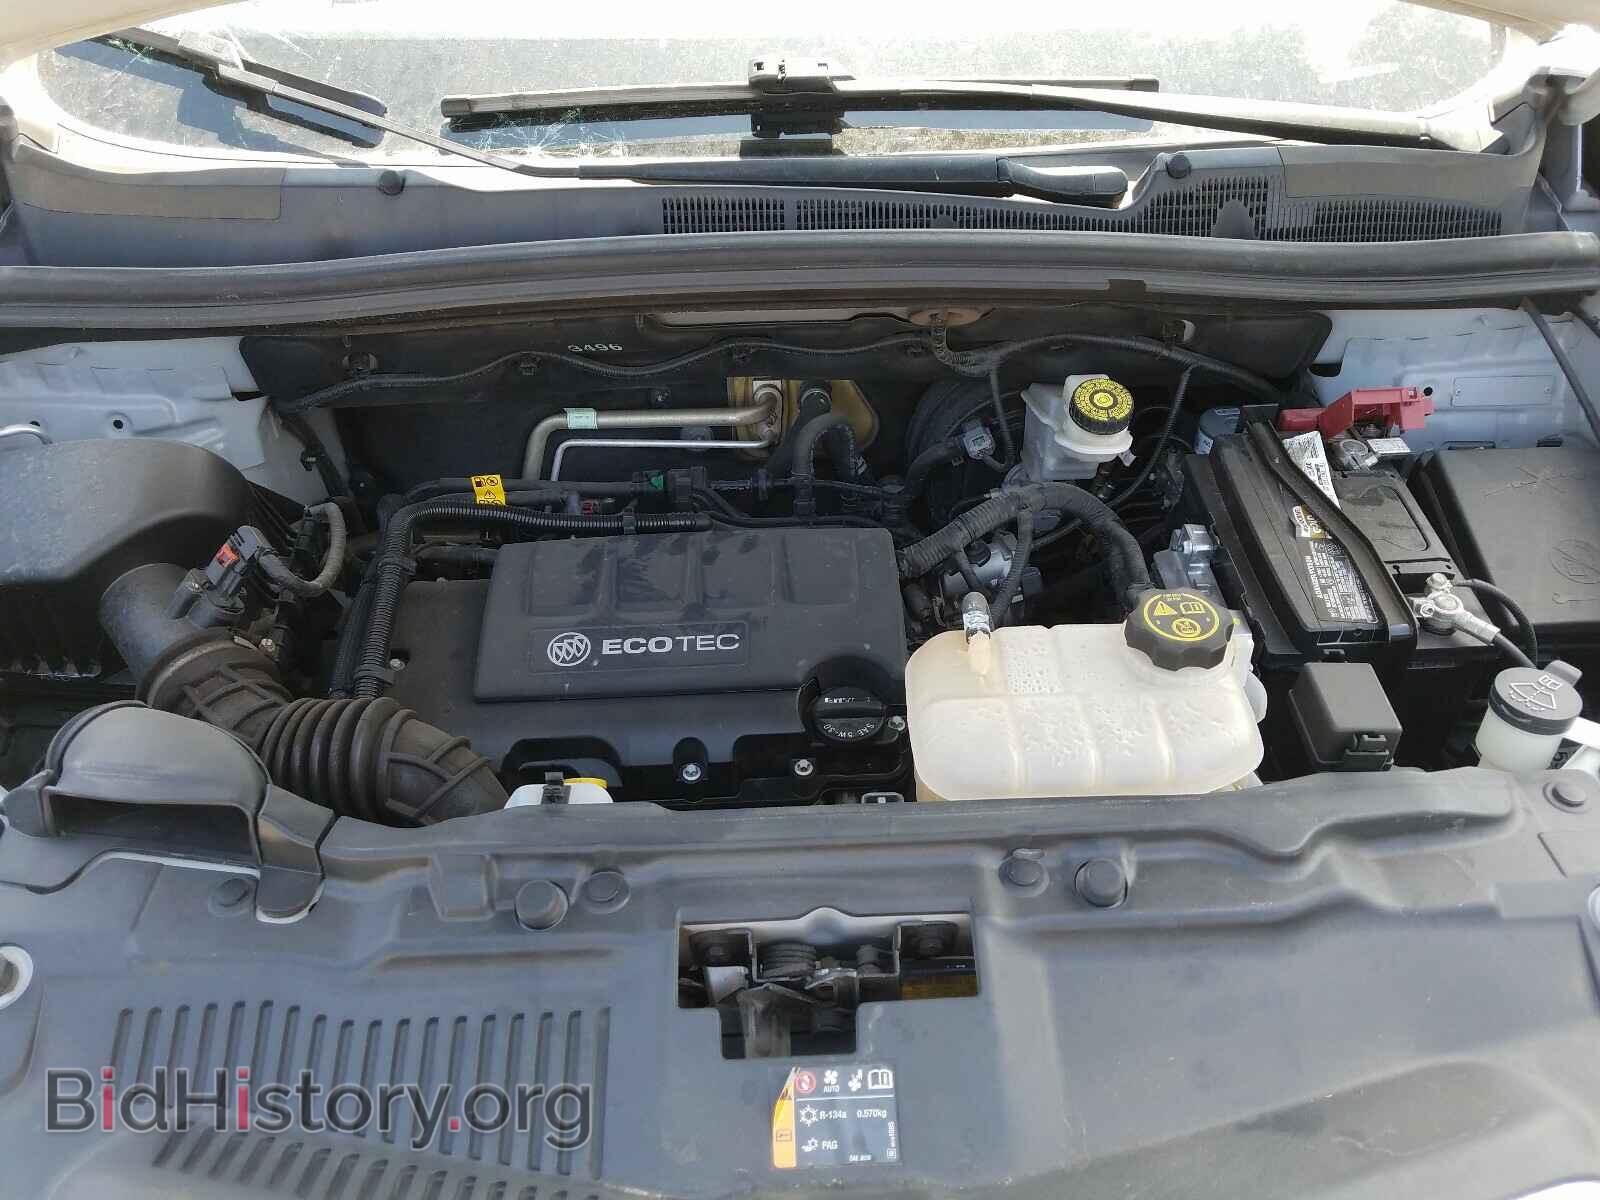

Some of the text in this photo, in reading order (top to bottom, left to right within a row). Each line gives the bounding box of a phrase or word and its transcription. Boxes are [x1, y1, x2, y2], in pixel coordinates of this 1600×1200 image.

[602, 634, 739, 654] ECOTEC
[823, 1085, 840, 1093] AUTO
[819, 1108, 887, 1120] R-134a 0.570kg
[821, 1140, 838, 1150] PAG
